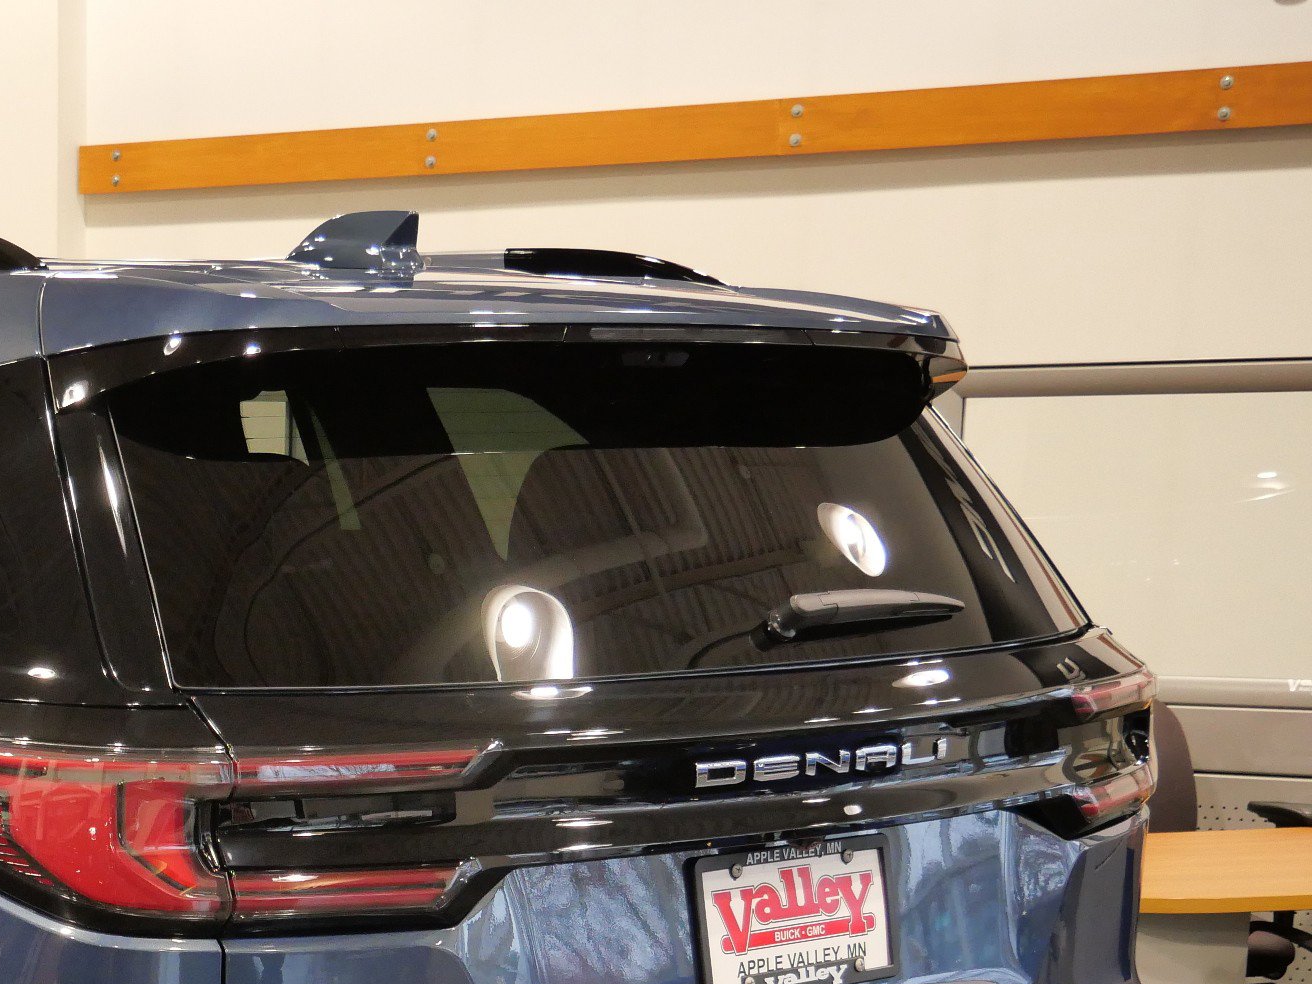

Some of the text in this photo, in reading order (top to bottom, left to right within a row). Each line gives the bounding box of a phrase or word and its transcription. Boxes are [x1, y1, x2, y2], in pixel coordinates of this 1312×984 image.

[695, 737, 947, 788] DENALI
[746, 849, 780, 865] APPLE
[826, 841, 842, 854] MN
[774, 924, 826, 942] BUICK GMC
[738, 955, 783, 976] APPLE
[847, 941, 867, 959] MN
